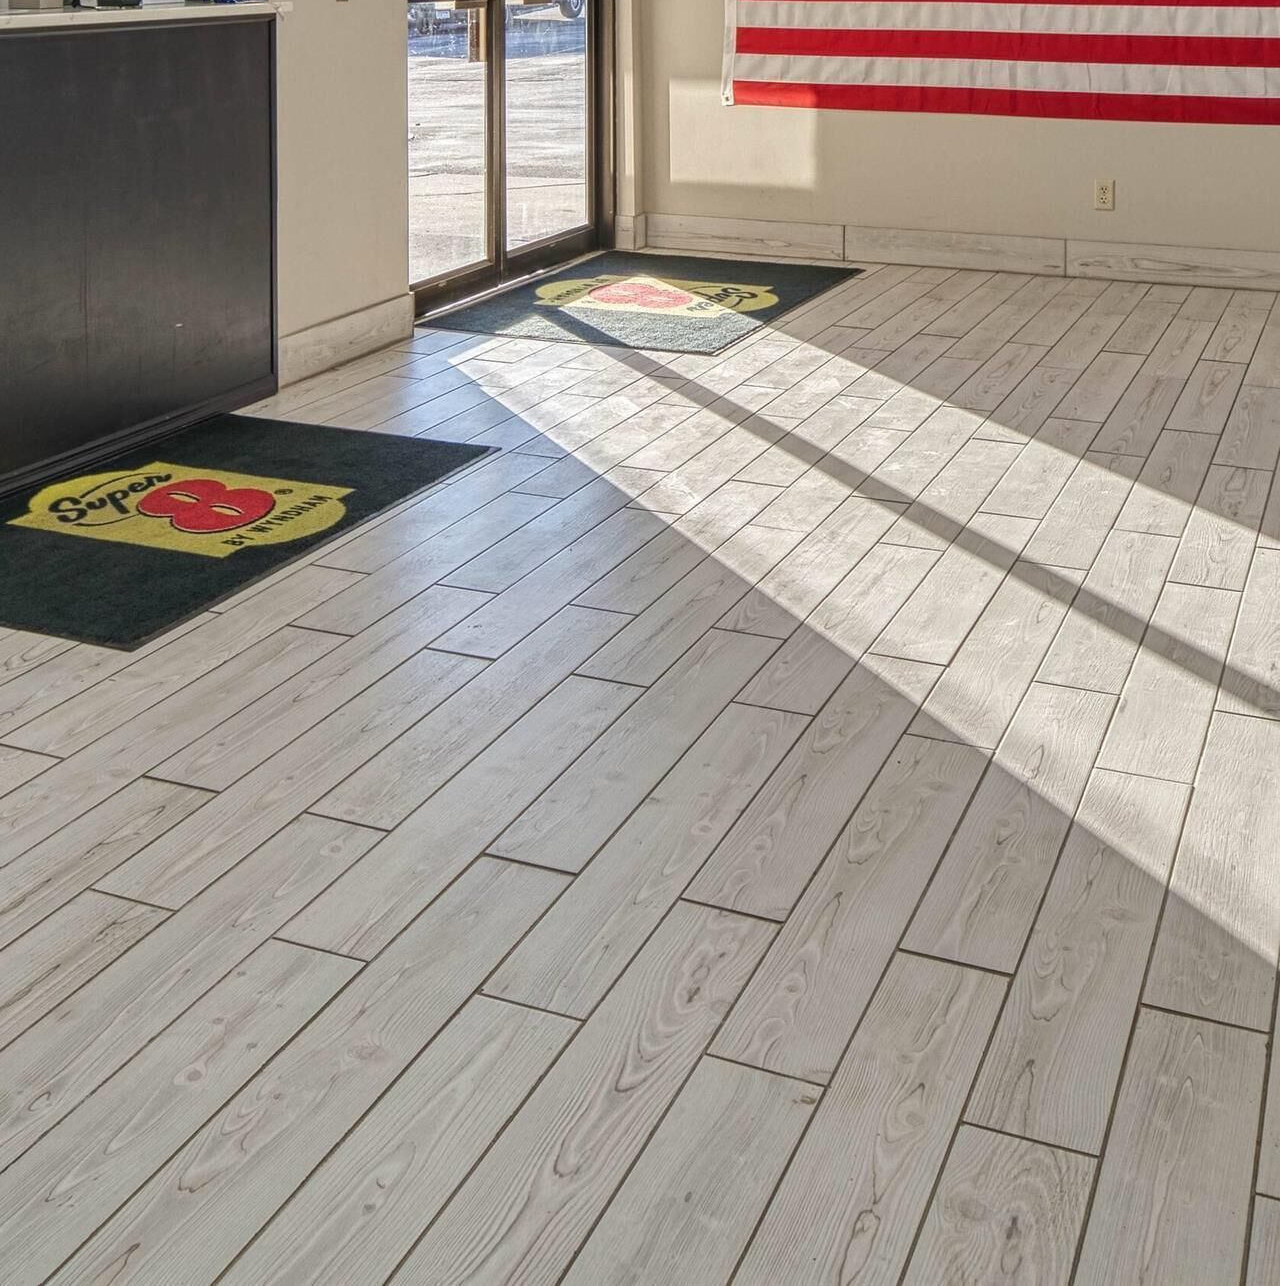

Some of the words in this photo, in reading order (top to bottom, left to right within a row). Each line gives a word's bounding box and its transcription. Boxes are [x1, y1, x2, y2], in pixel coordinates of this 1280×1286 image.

[48, 472, 172, 524] Super
[136, 479, 276, 534] 8
[221, 533, 255, 548] BY
[249, 495, 335, 536] WYNDHAM
